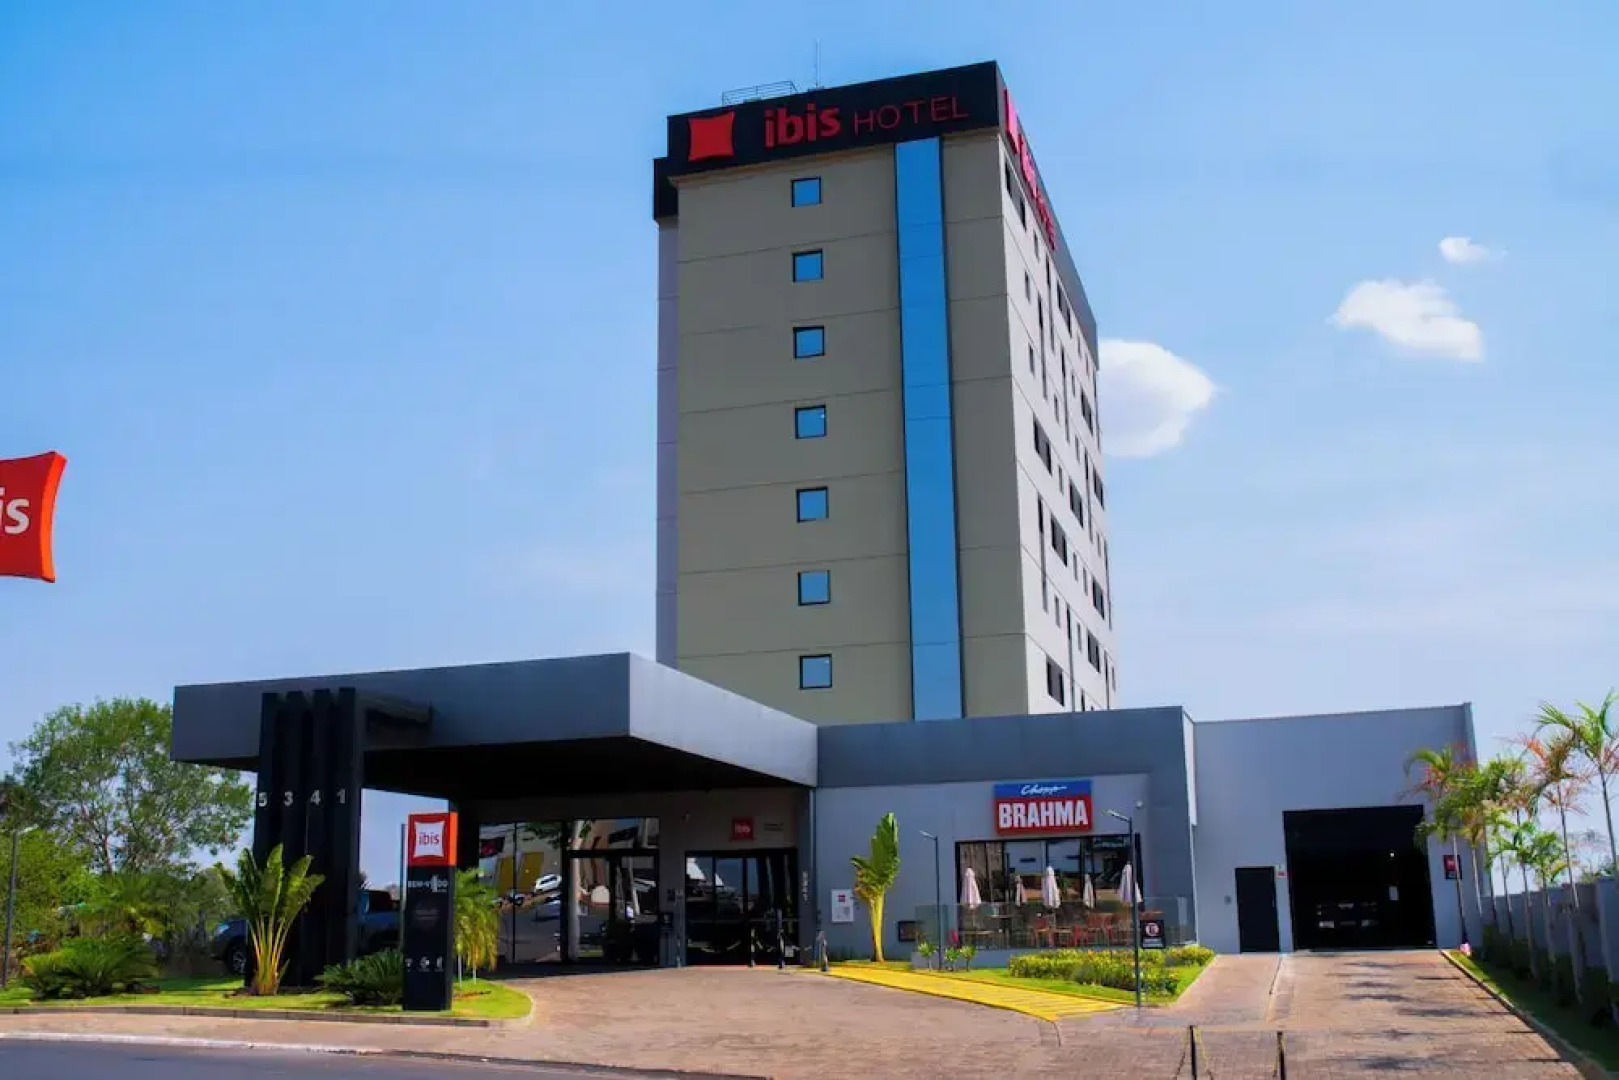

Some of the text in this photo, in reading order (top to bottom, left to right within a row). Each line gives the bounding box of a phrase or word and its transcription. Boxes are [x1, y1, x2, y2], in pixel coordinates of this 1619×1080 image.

[764, 96, 969, 148] ibis HOTEL
[998, 800, 1089, 828] BRAHMA
[418, 832, 440, 845] ibis
